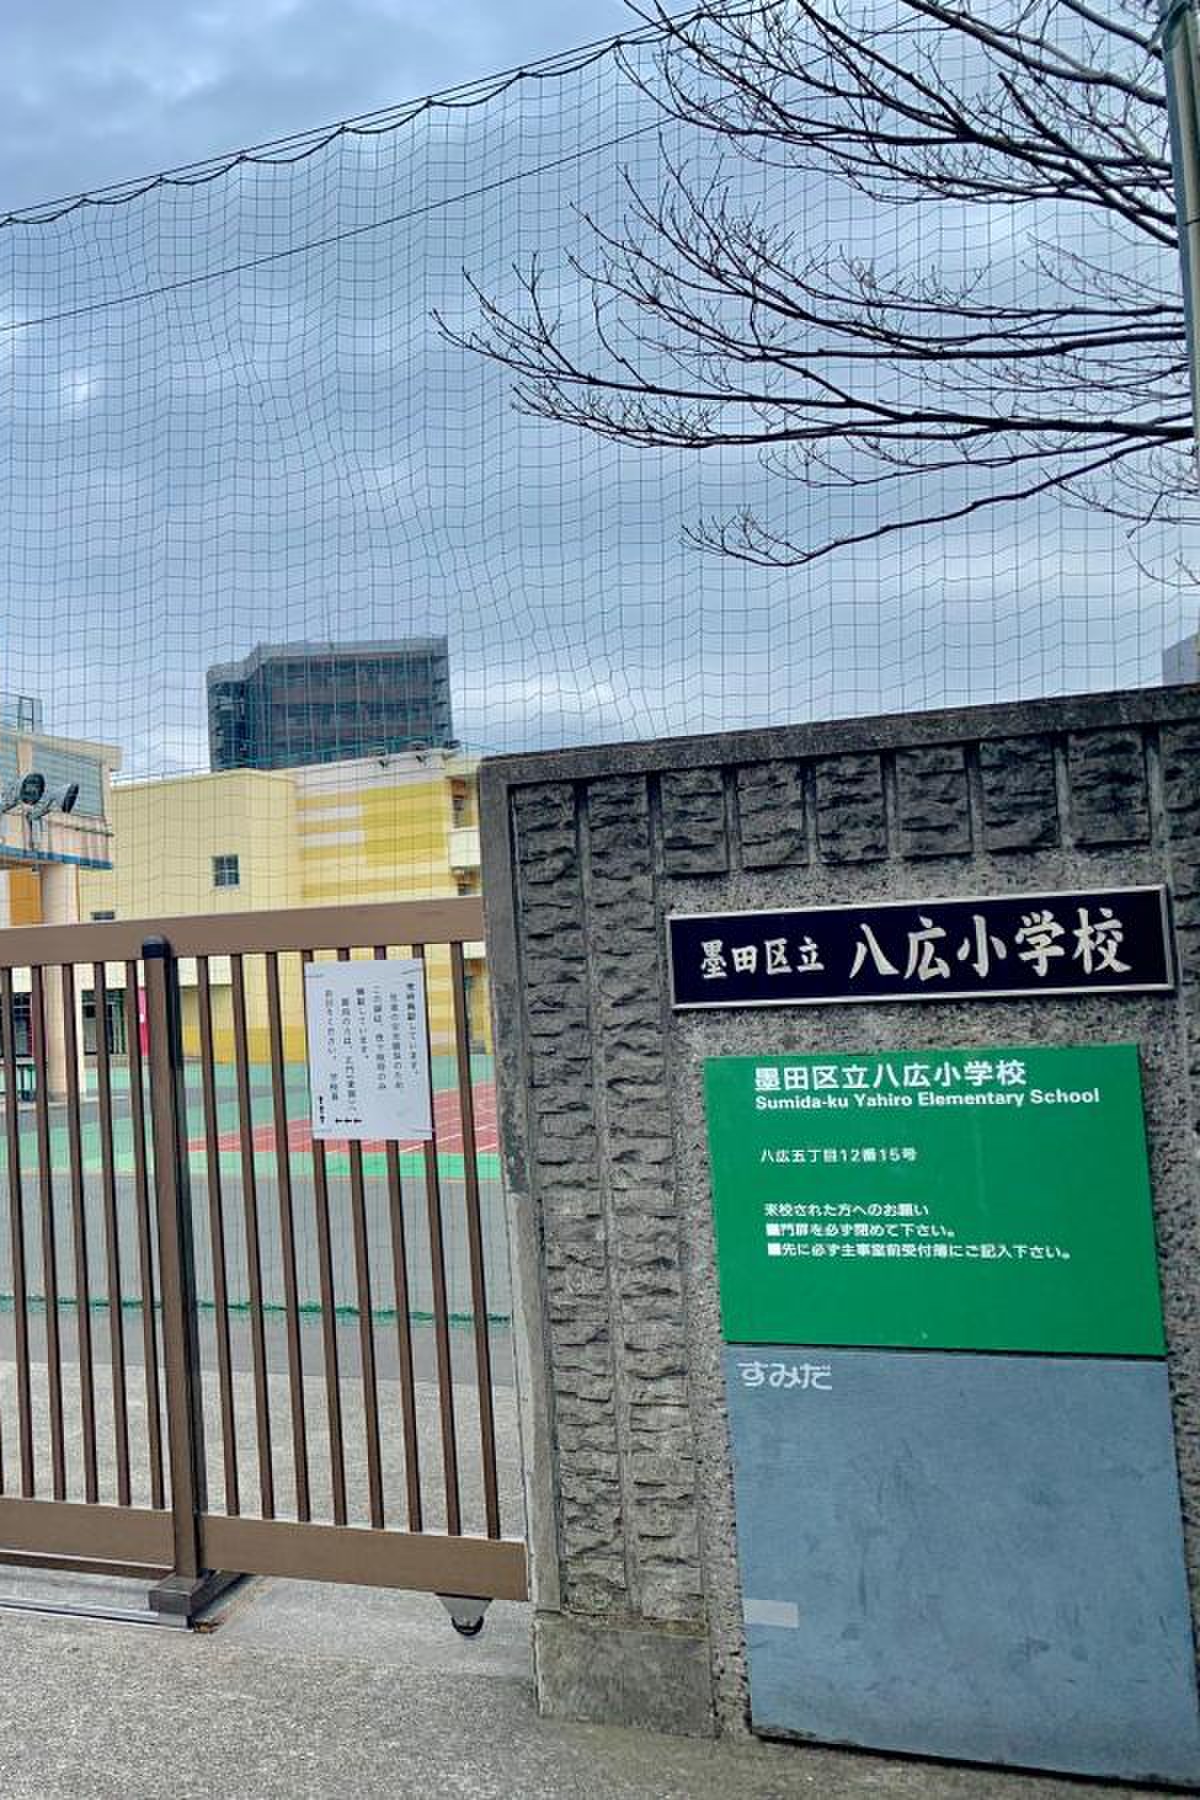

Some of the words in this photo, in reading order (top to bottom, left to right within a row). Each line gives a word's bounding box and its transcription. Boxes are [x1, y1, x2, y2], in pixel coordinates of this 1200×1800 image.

[700, 936, 825, 979] 墨田区立
[849, 906, 1132, 980] 八広小学校
[754, 1060, 1027, 1091] 墨田区立八広小学校
[755, 1094, 849, 1110] Sumida-ku
[854, 1093, 913, 1107] Yahiro
[917, 1091, 1025, 1108] Elementary
[1030, 1087, 1100, 1104] School
[737, 1361, 833, 1391] すみだ
